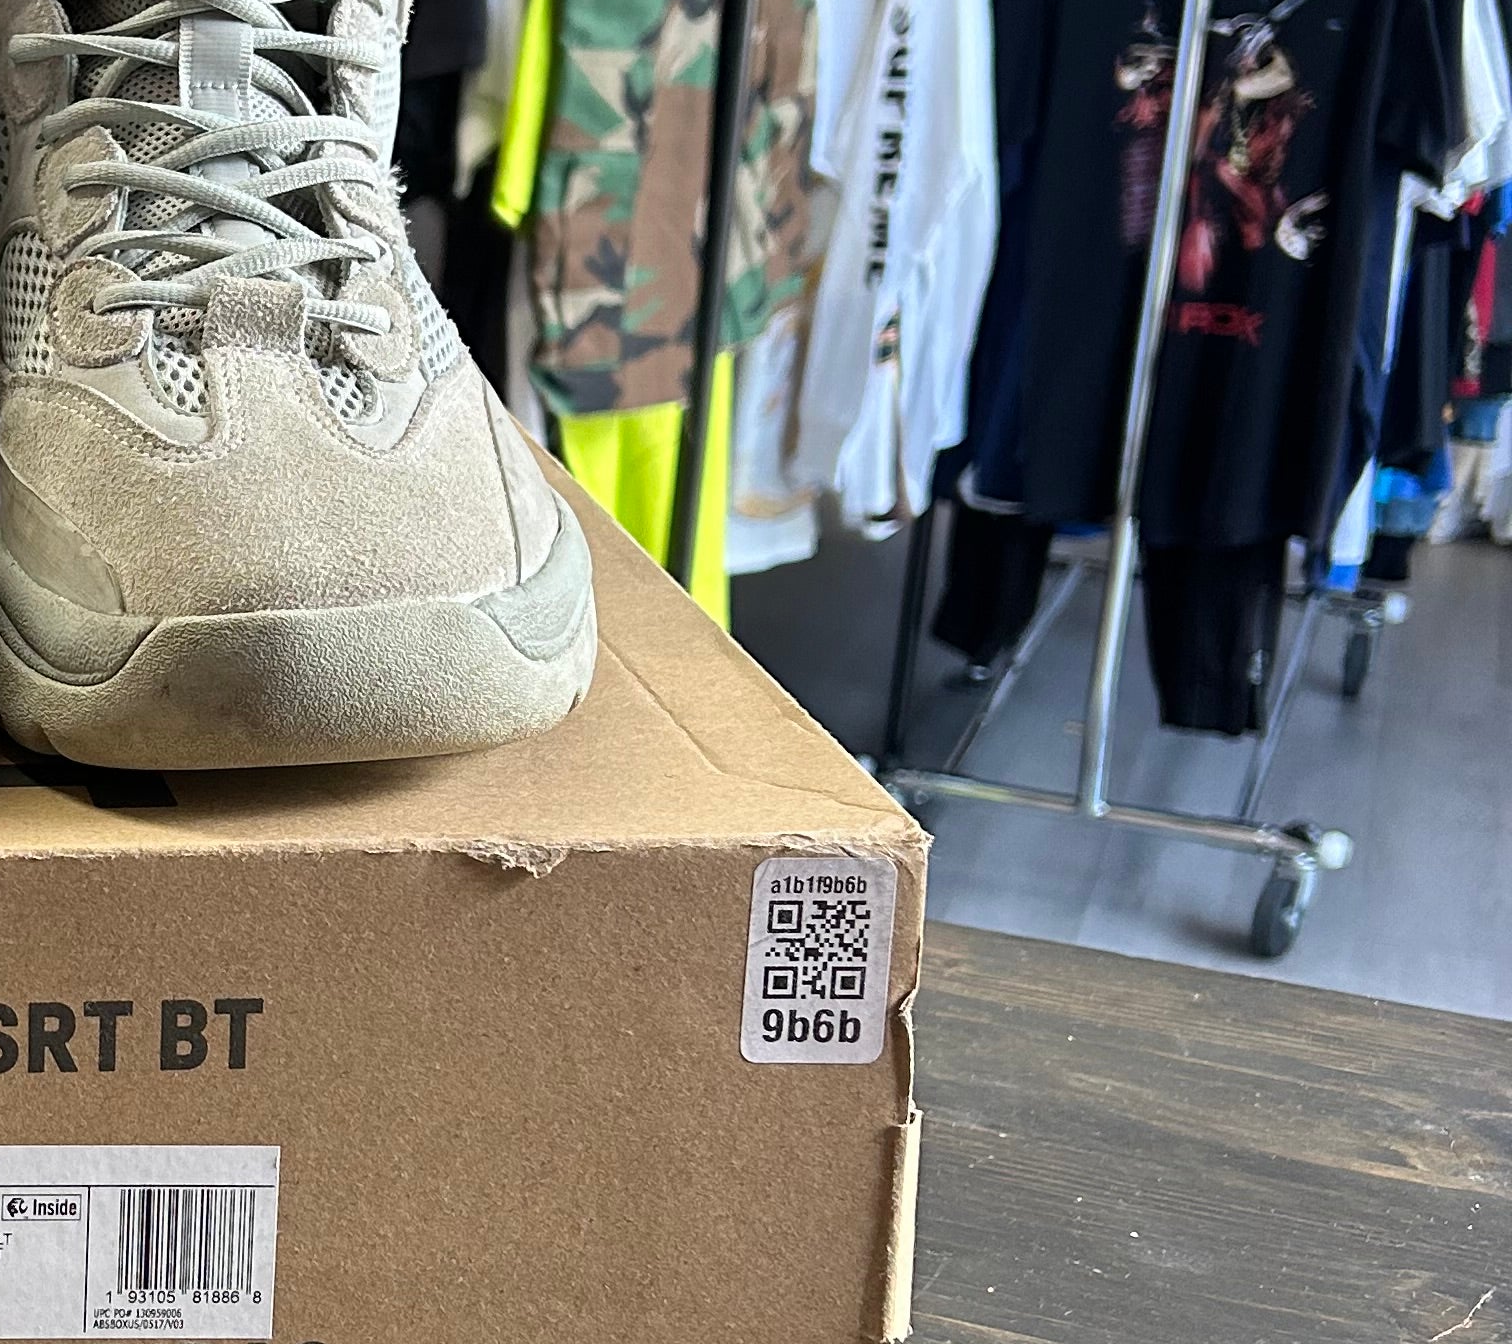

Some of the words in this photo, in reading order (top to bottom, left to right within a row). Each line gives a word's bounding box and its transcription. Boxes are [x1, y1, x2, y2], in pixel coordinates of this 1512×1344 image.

[771, 875, 867, 894] a1b1f9b6b
[160, 997, 264, 1071] BT
[762, 1008, 861, 1044] 9b6b
[33, 1199, 77, 1216] Inside
[105, 1291, 112, 1304] 1
[127, 1290, 176, 1304] 93105
[192, 1290, 240, 1304] 81886
[252, 1290, 262, 1304] 8
[93, 1309, 111, 1318] UPC
[114, 1309, 132, 1318] PO#
